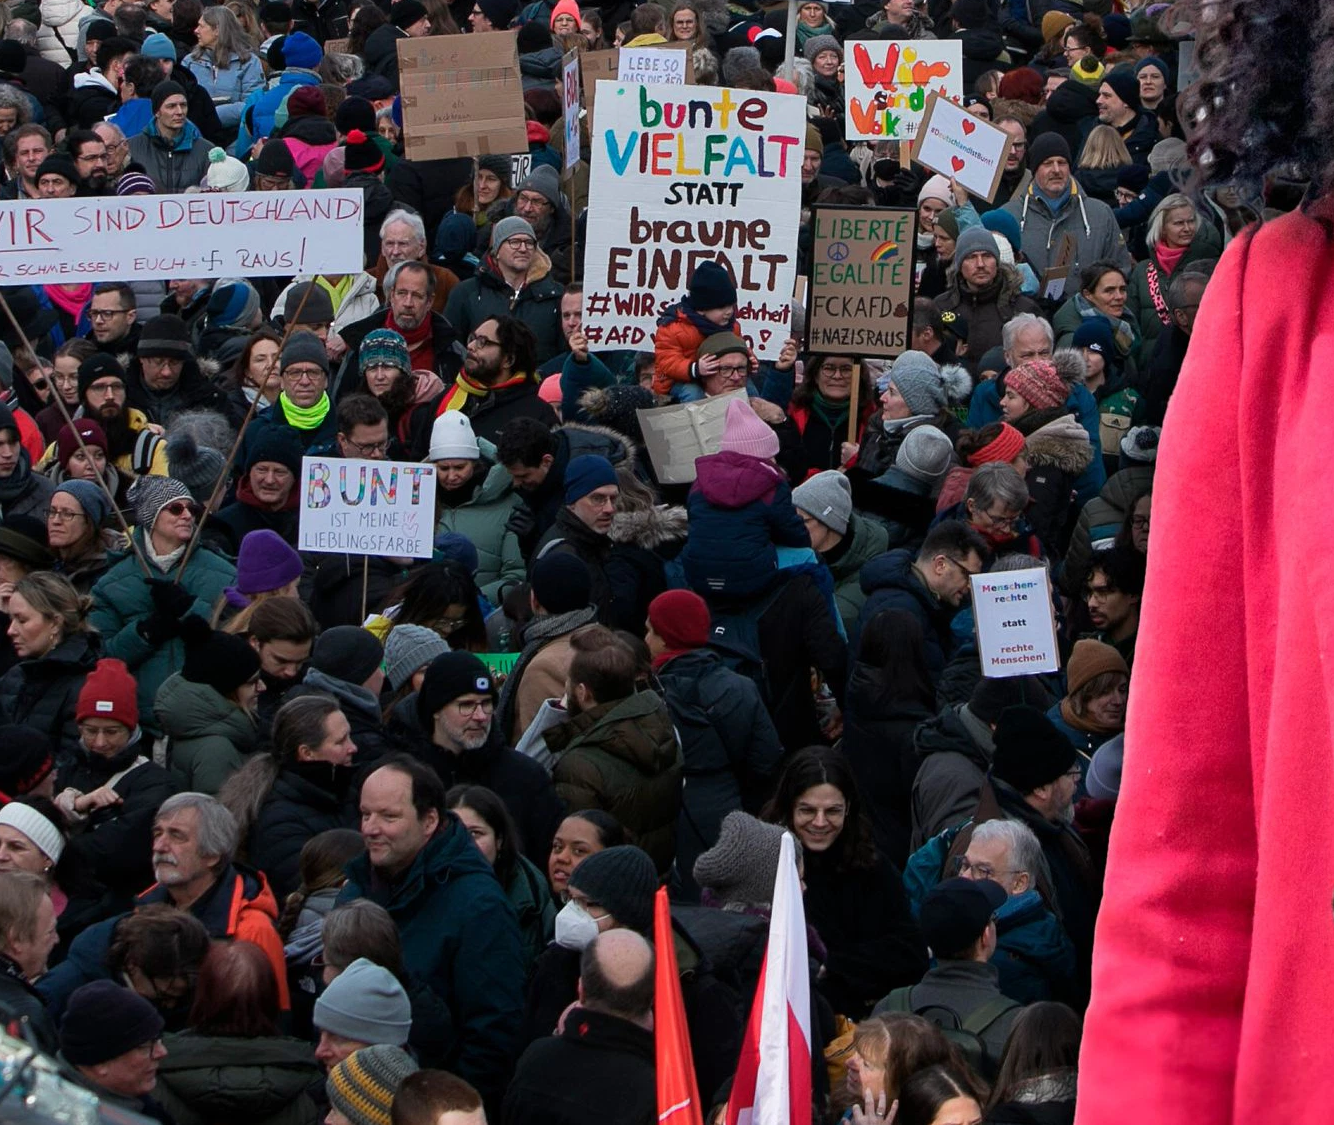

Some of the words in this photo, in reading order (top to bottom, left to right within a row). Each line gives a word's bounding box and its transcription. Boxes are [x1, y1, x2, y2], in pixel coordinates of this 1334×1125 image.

[628, 57, 659, 71] LEBE
[663, 58, 680, 71] SO
[853, 43, 951, 89] Wir
[639, 85, 768, 131] bunte
[605, 129, 800, 178] VIELFALT
[930, 126, 995, 167] #DeutschlandIstBunt!
[664, 182, 744, 207] STATT
[73, 206, 146, 235] SIND
[156, 195, 362, 229] DEUTSCHLAND!
[629, 206, 771, 250] braune
[815, 215, 908, 243] LIBERTÉ
[235, 237, 307, 273] RAUS!
[814, 258, 904, 287] EGALITÉ
[812, 295, 893, 318] FCKAFD
[584, 325, 646, 345] #AfD
[811, 328, 905, 348] #NAZISRAUS
[308, 463, 433, 509] BUNT
[331, 512, 351, 528] IST
[359, 512, 399, 528] MEINE
[304, 531, 422, 554] LIEBLINGSFARBE
[982, 582, 1038, 592] Menschen-
[995, 594, 1028, 603] rechte
[1002, 618, 1027, 628] statt
[991, 652, 1046, 665] Menschen!
[1001, 643, 1034, 653] rechte
